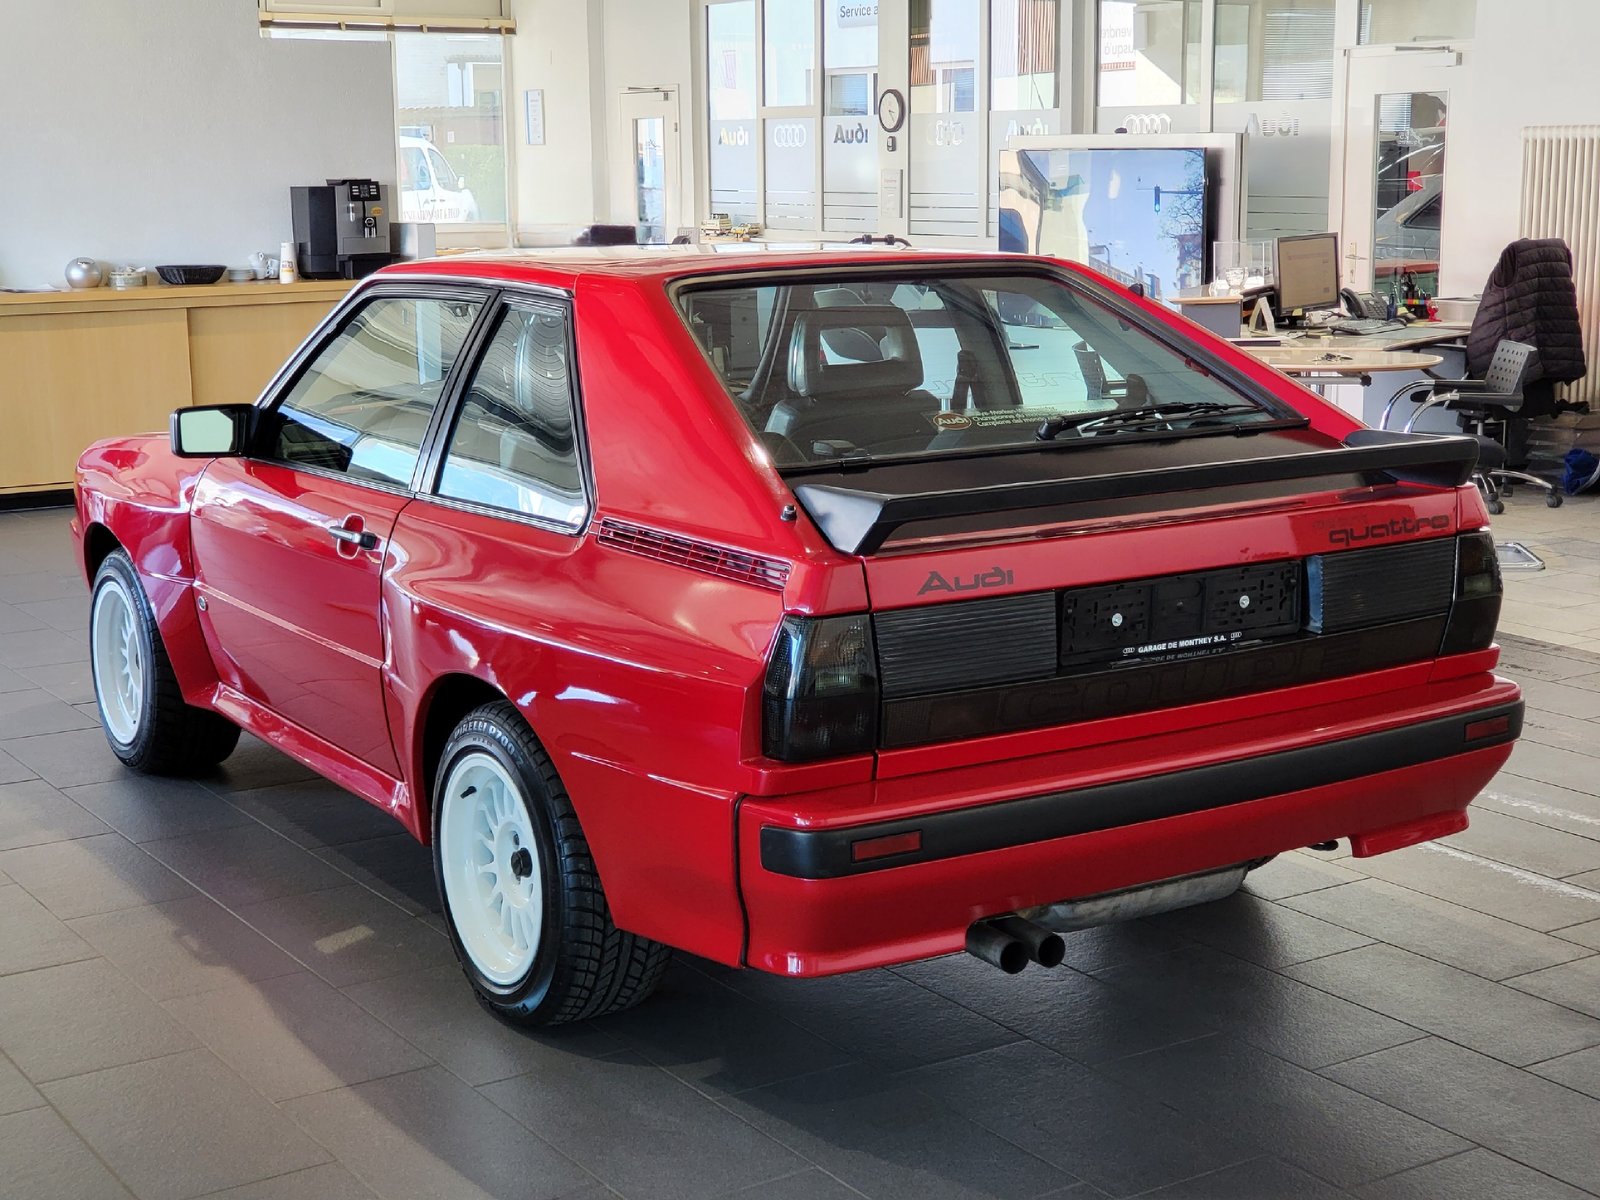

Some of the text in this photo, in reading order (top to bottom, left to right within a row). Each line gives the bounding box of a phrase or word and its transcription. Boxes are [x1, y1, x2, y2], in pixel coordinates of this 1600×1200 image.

[839, 3, 871, 18] Service
[1005, 117, 1049, 136] Audi
[1246, 111, 1300, 137] Audi
[718, 127, 749, 146] Audi
[833, 123, 869, 145] Audi
[937, 416, 969, 426] Audi
[1328, 514, 1450, 547] quattro
[916, 566, 1014, 596] Audi
[1138, 634, 1227, 653] GARAGE DE MONTHEY S.A.
[454, 720, 488, 740] PIRELLI
